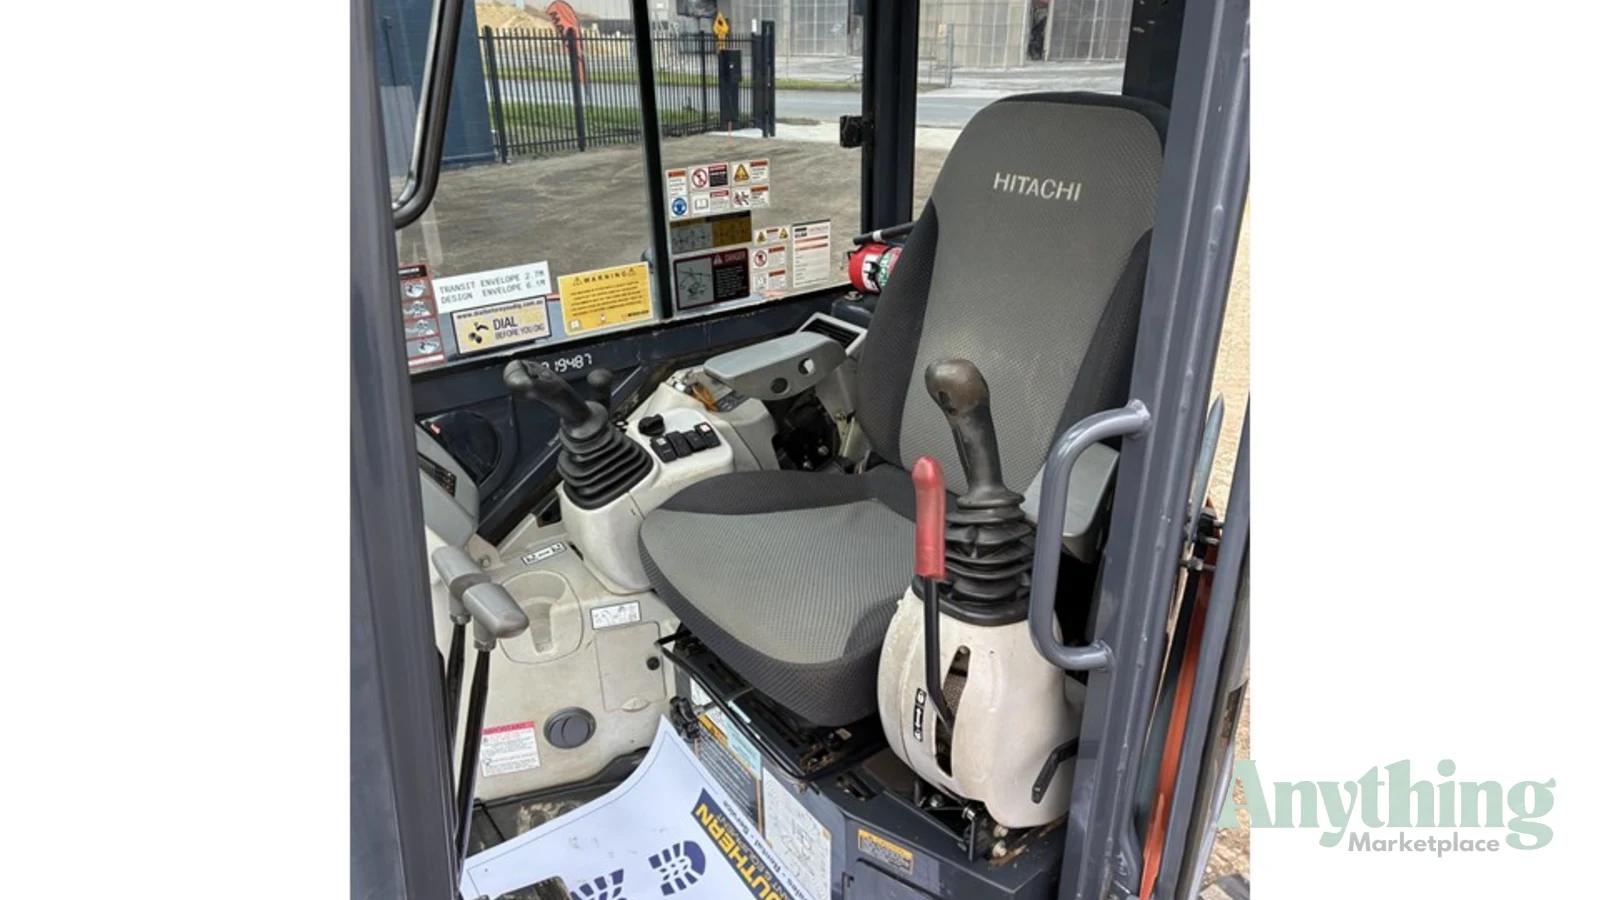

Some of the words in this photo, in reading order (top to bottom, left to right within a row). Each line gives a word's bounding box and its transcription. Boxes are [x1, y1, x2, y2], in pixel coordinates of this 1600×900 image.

[993, 171, 1082, 202] HITACHI
[440, 281, 475, 295] TRANSIT
[480, 273, 520, 288] ENVELOPE
[583, 270, 628, 284] WARNING
[441, 292, 473, 305] DESIGN
[482, 283, 521, 298] ENVELOPE
[493, 316, 518, 331] DIAL
[722, 799, 750, 836] Service
[753, 839, 781, 873] Rental
